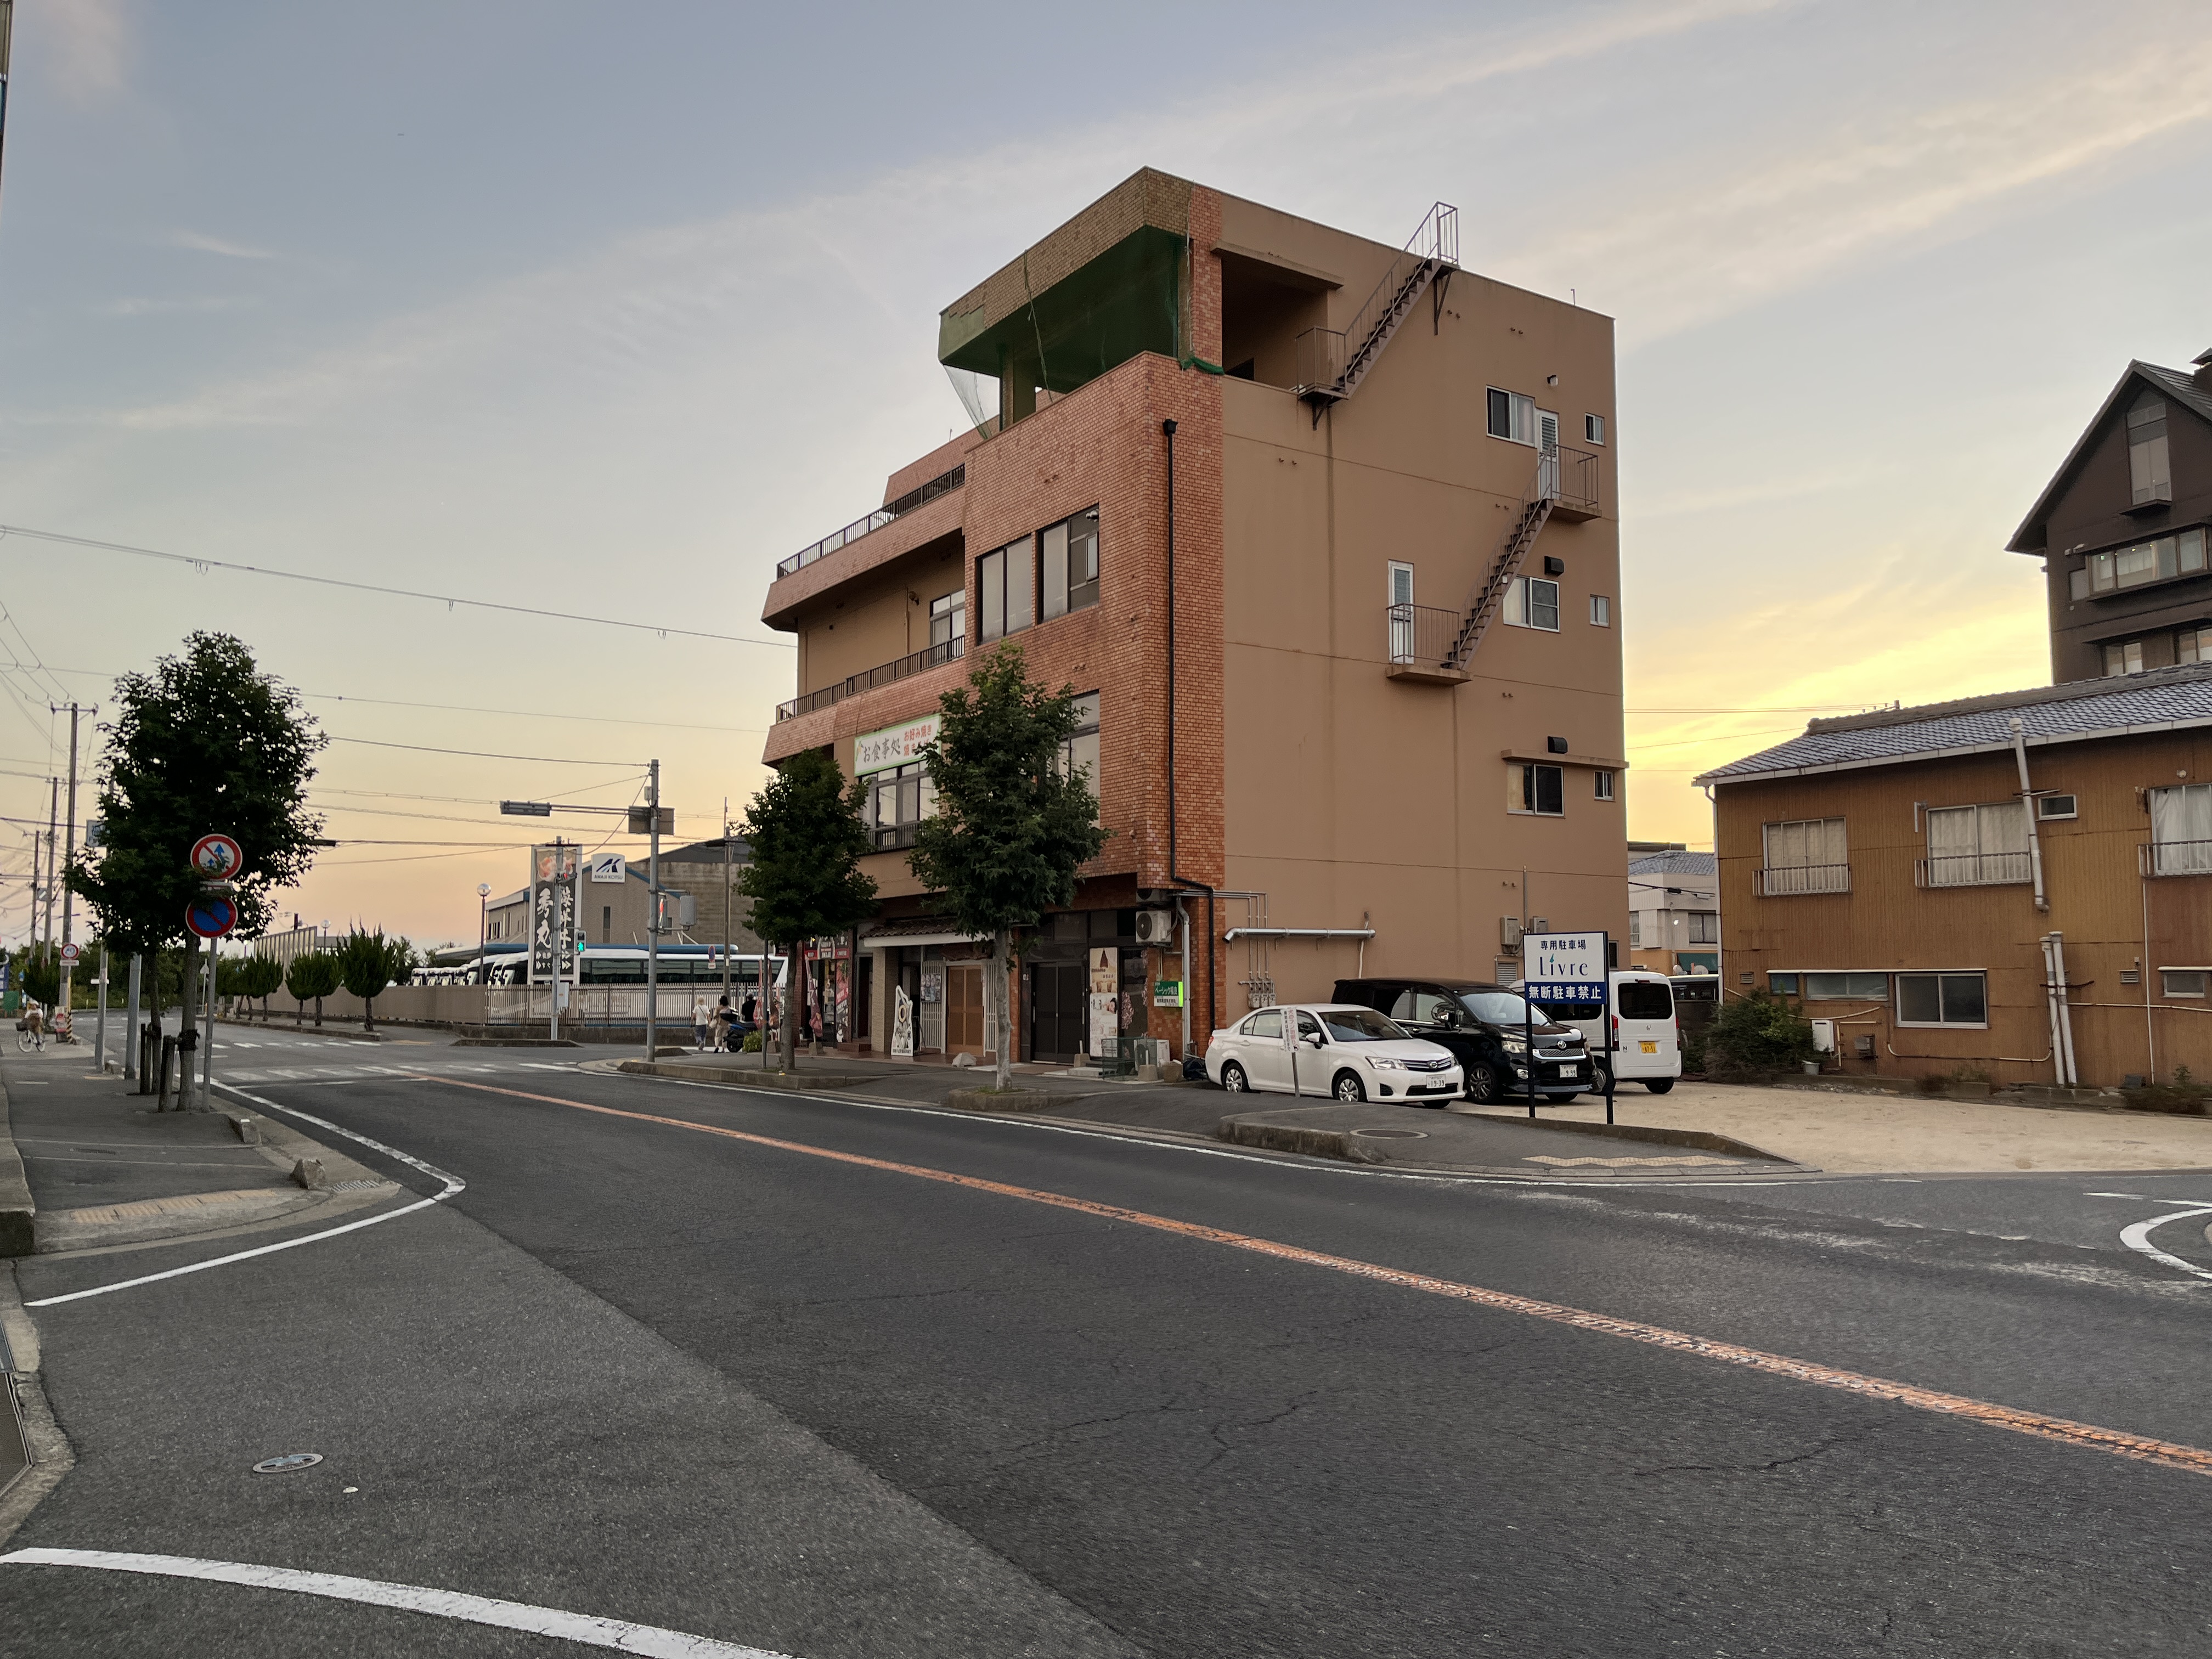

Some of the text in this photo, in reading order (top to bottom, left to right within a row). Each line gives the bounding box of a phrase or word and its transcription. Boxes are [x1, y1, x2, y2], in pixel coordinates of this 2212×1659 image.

[904, 724, 932, 741] お好み焼き
[864, 737, 901, 763] お食事処
[535, 888, 554, 949] 秀丸
[1541, 939, 1586, 951] 専用駐車場
[1539, 953, 1588, 976] Livre
[1528, 985, 1602, 1000] 無断駐車禁止
